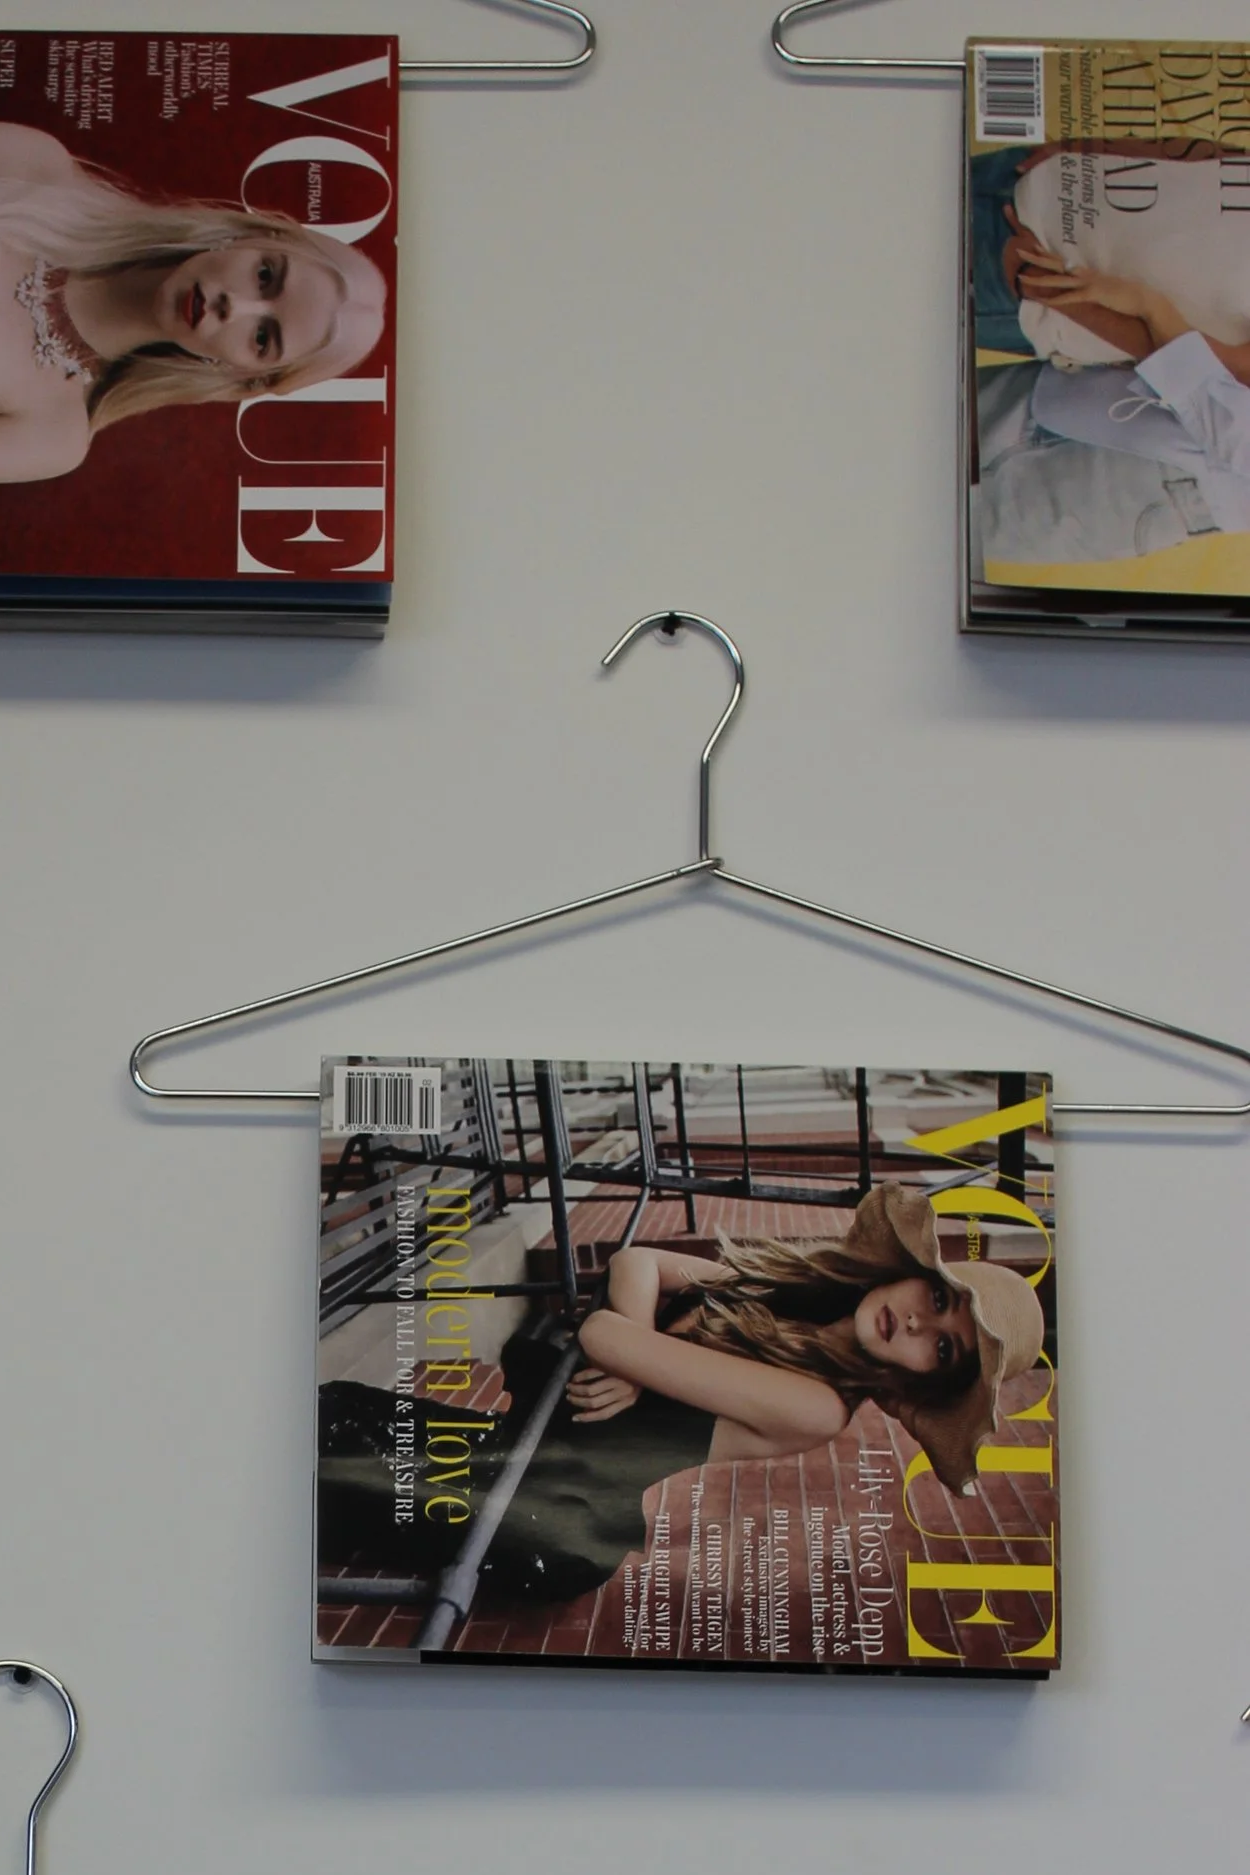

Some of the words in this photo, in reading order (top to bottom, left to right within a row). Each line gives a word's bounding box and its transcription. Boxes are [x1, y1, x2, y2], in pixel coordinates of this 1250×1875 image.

[0, 40, 16, 88] SUPER
[82, 41, 98, 82] What's
[98, 41, 115, 72] RED
[180, 42, 197, 98] Fashion's
[197, 41, 213, 89] TIMES
[213, 42, 230, 111] SURREAL
[77, 84, 97, 130] driving
[97, 74, 114, 123] ALERT
[1159, 51, 1214, 161] DAYS
[1101, 52, 1158, 213] AHEAD
[1060, 156, 1075, 169] &
[1060, 172, 1078, 197] the
[308, 162, 321, 222] AUSTRALIA
[1058, 197, 1078, 245] planet
[1075, 204, 1099, 229] for
[236, 44, 393, 573] VOUE
[396, 1185, 415, 1268] FASHION
[396, 1274, 415, 1299] TO
[424, 1186, 495, 1392] modern
[396, 1305, 415, 1350] FALL
[396, 1357, 415, 1394] FOR
[396, 1400, 414, 1413] &
[395, 1418, 415, 1523] TREASURE
[423, 1418, 495, 1524] love
[655, 1512, 670, 1544] THE
[743, 1517, 755, 1537] the
[773, 1509, 789, 1544] BILL
[851, 1449, 895, 1577] Lily-Rose
[706, 1524, 722, 1590] CHRISSY
[743, 1539, 754, 1574] street
[807, 1506, 828, 1569] ingenue
[830, 1524, 851, 1578] Model,
[624, 1564, 636, 1603] online
[655, 1549, 670, 1598] RIGHT
[758, 1535, 770, 1593] Exclusive
[811, 1573, 825, 1592] on
[741, 1576, 754, 1606] style
[773, 1547, 790, 1653] CUNNINGHAM
[811, 1597, 830, 1622] the
[832, 1583, 849, 1638] actress
[622, 1605, 636, 1650] dating?
[655, 1601, 671, 1651] SWIPE
[707, 1594, 723, 1652] TEIGEN
[741, 1607, 754, 1653] pioneer
[756, 1595, 770, 1637] images
[851, 1586, 895, 1656] Depp
[756, 1639, 771, 1653] by
[812, 1626, 829, 1655] rise
[832, 1643, 851, 1656] &
